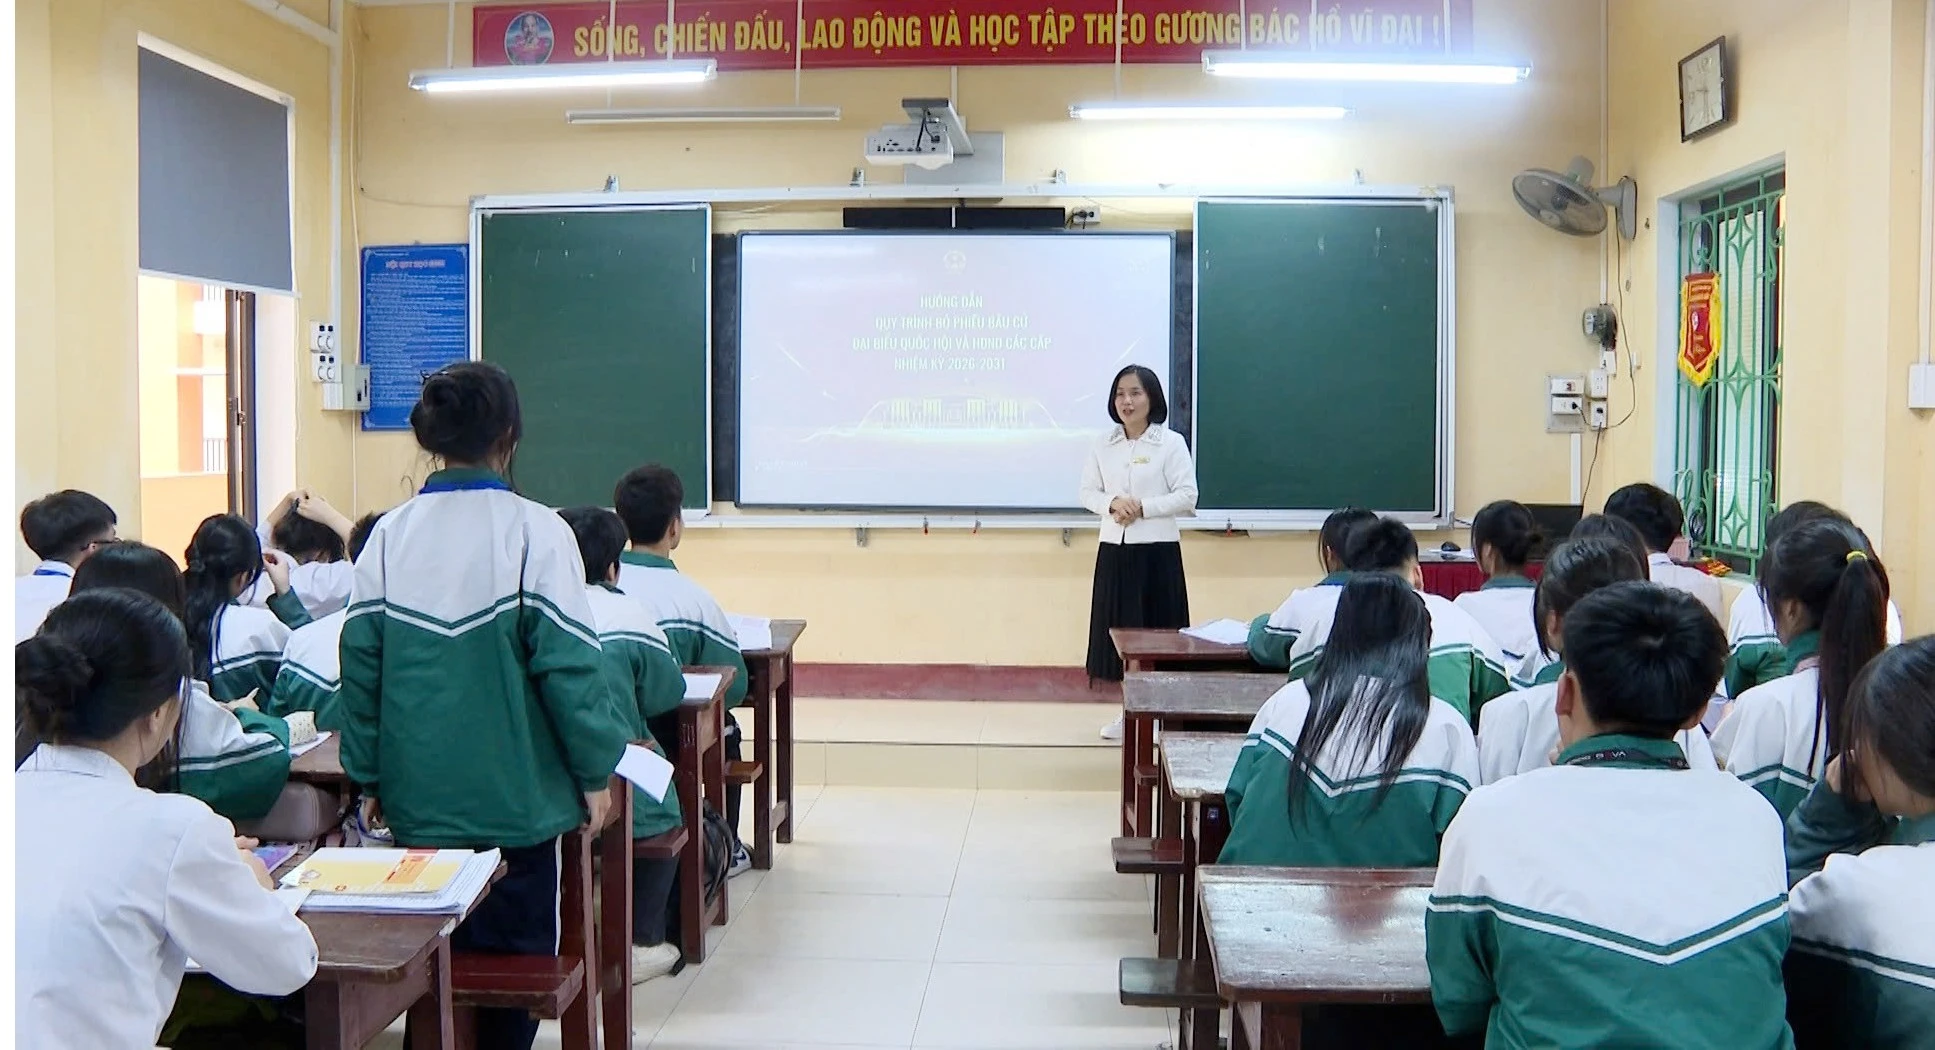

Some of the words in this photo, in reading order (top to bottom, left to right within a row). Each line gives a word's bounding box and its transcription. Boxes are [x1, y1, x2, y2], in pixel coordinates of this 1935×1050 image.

[574, 16, 645, 57] SỐNG,
[654, 12, 727, 54] CHIẾN
[734, 10, 790, 53] ĐẤU,
[801, 18, 845, 50] LAO
[853, 11, 921, 54] ĐỘNG
[929, 9, 962, 47] VÀ
[970, 14, 1020, 52] HỌC
[1028, 7, 1075, 52] TẬP
[1083, 13, 1146, 46] THEO
[1155, 10, 1240, 45] GƯƠNG
[1250, 8, 1299, 44] BÁC
[1309, 3, 1341, 44] HỒ
[1350, 8, 1373, 44] VĨ
[1381, 14, 1422, 49] ĐẠI
